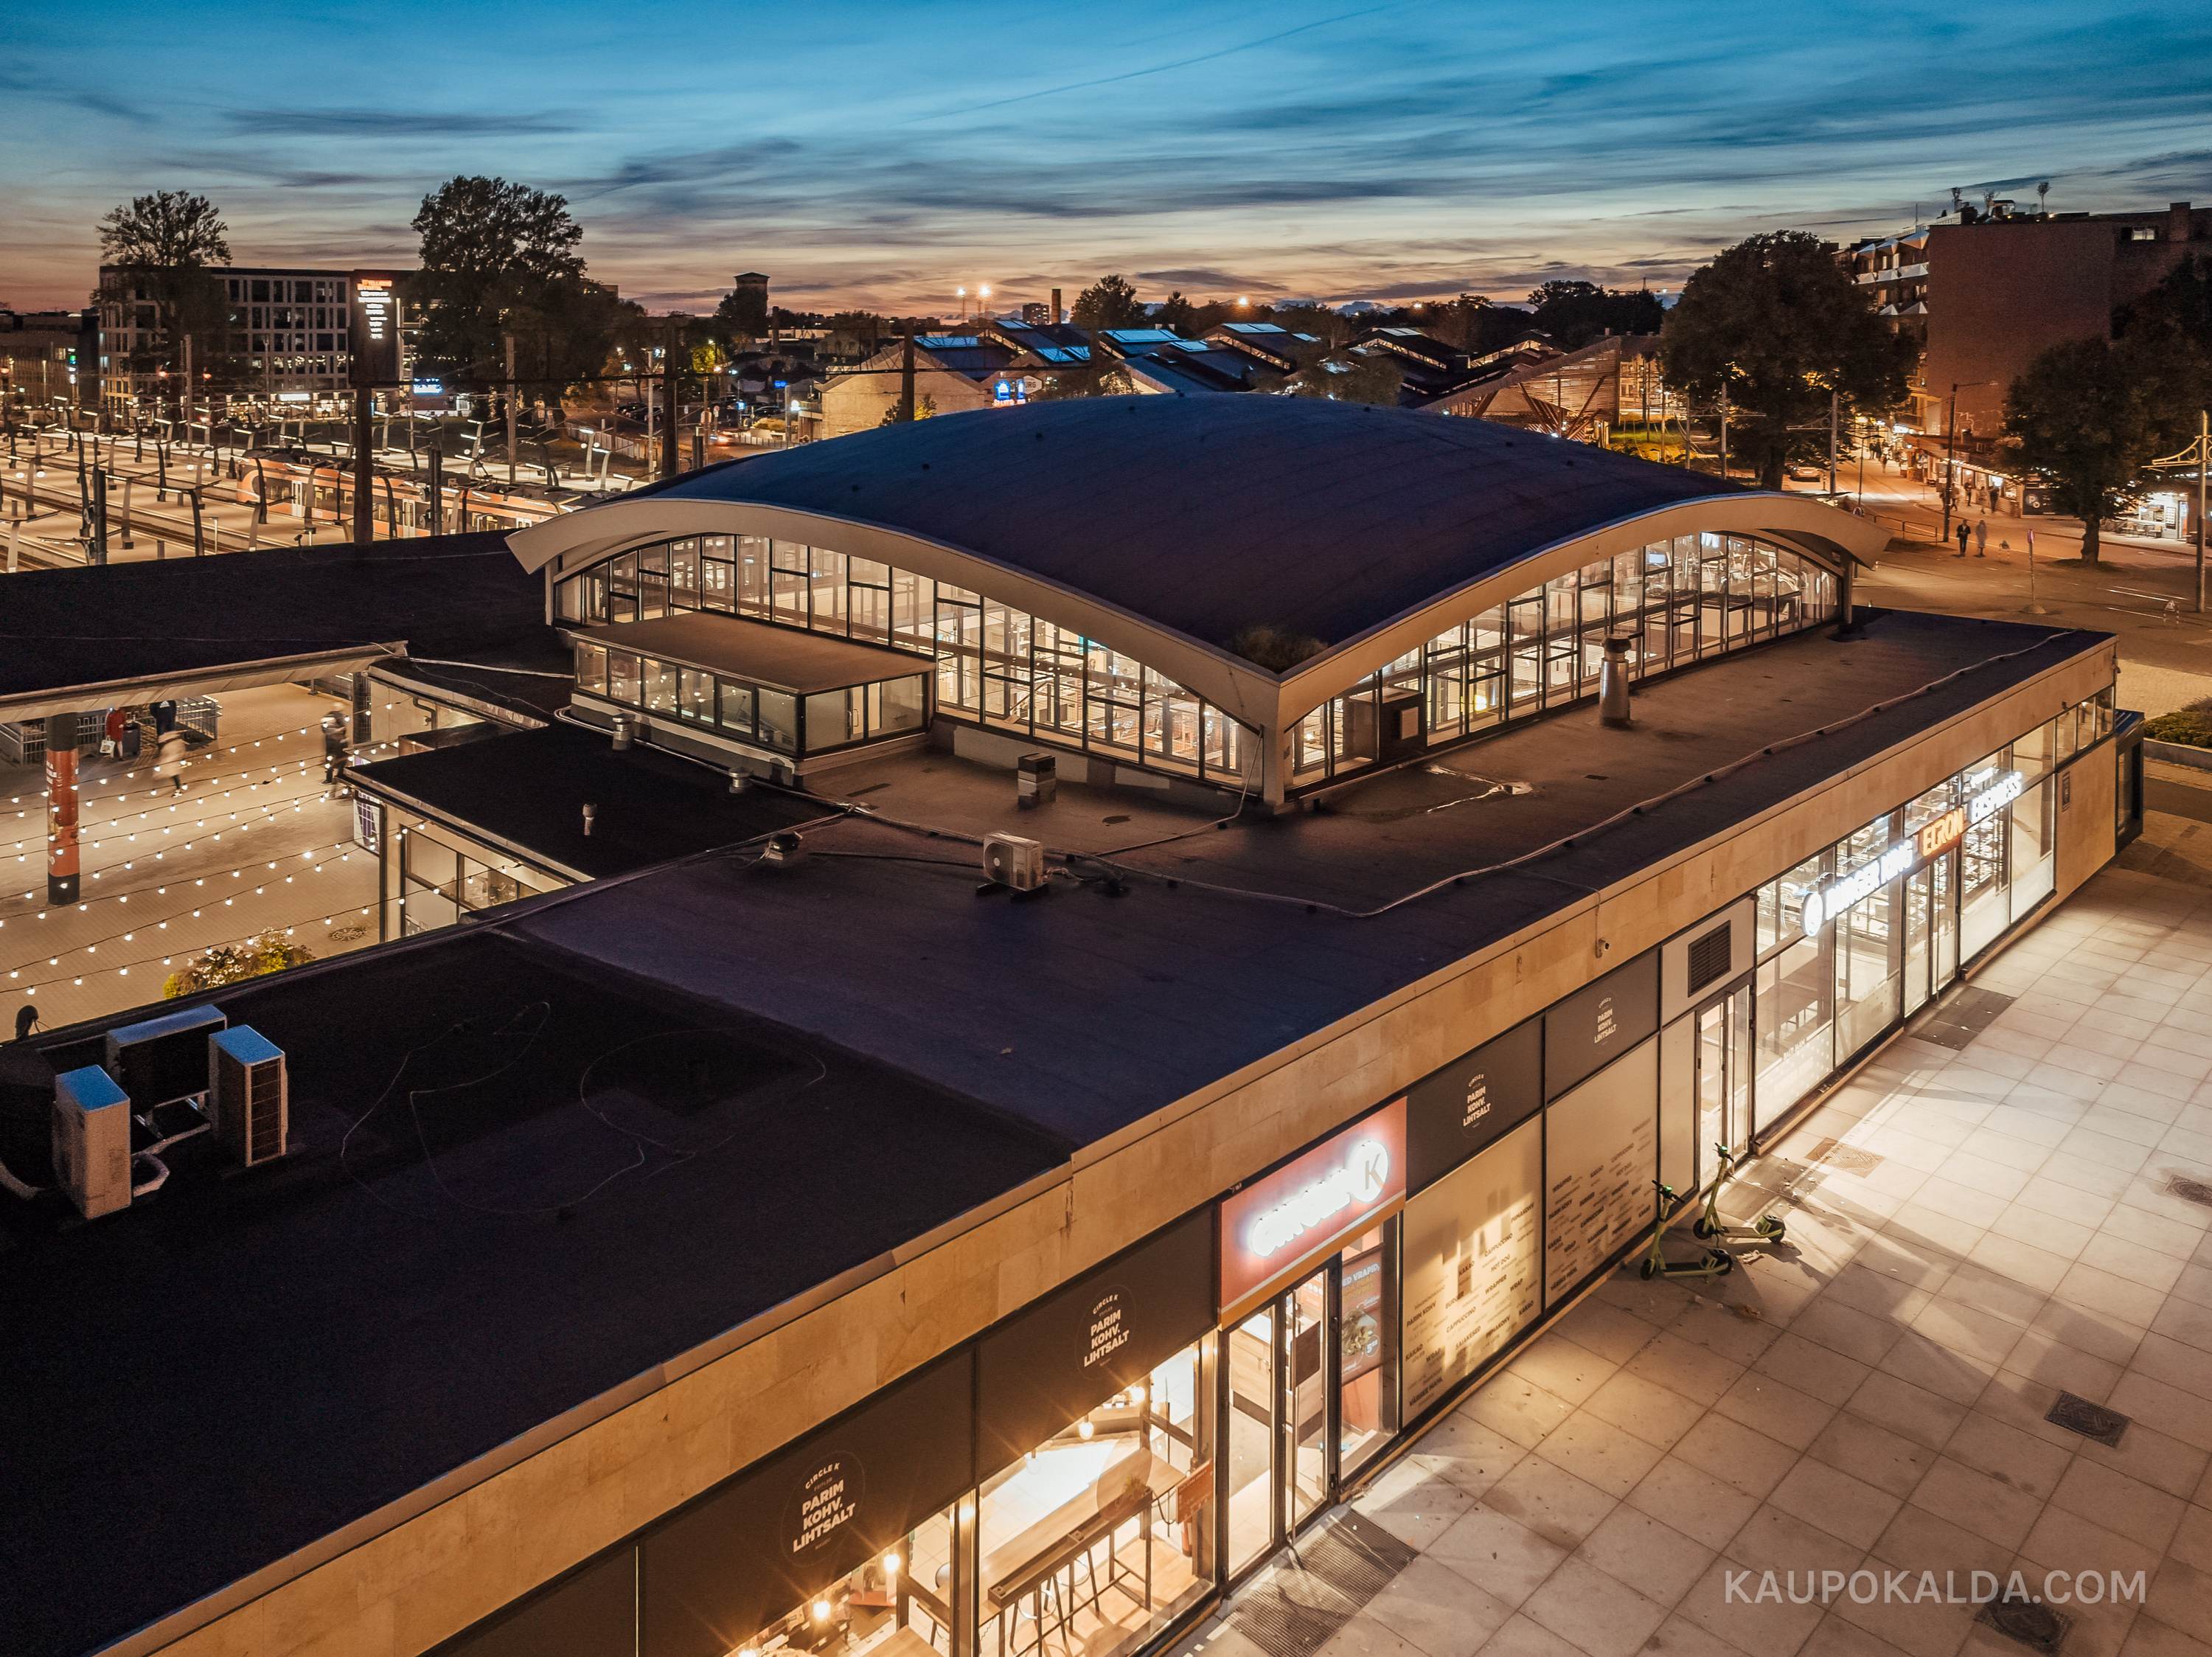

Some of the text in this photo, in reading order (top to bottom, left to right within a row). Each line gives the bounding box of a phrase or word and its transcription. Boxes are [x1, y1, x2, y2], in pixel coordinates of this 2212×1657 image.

[1922, 807, 1964, 857] ELRON
[1467, 1085, 1486, 1104] PARIM
[1463, 1102, 1491, 1127] LIHTSALT
[1364, 1152, 1385, 1192] K
[1484, 1232, 1513, 1257] CAPPUCCINO
[1093, 1295, 1113, 1314] CIRCLE
[1091, 1309, 1121, 1336] PARIM
[1446, 1306, 1476, 1333] CAPPUCCINO
[1084, 1330, 1129, 1367] LIHTSALT
[1091, 1323, 1120, 1349] KOHV.
[805, 1464, 833, 1490] CIRCLE
[802, 1479, 844, 1515] PARIM
[803, 1496, 843, 1531] KOHV.
[793, 1502, 855, 1553] LIHTSALT
